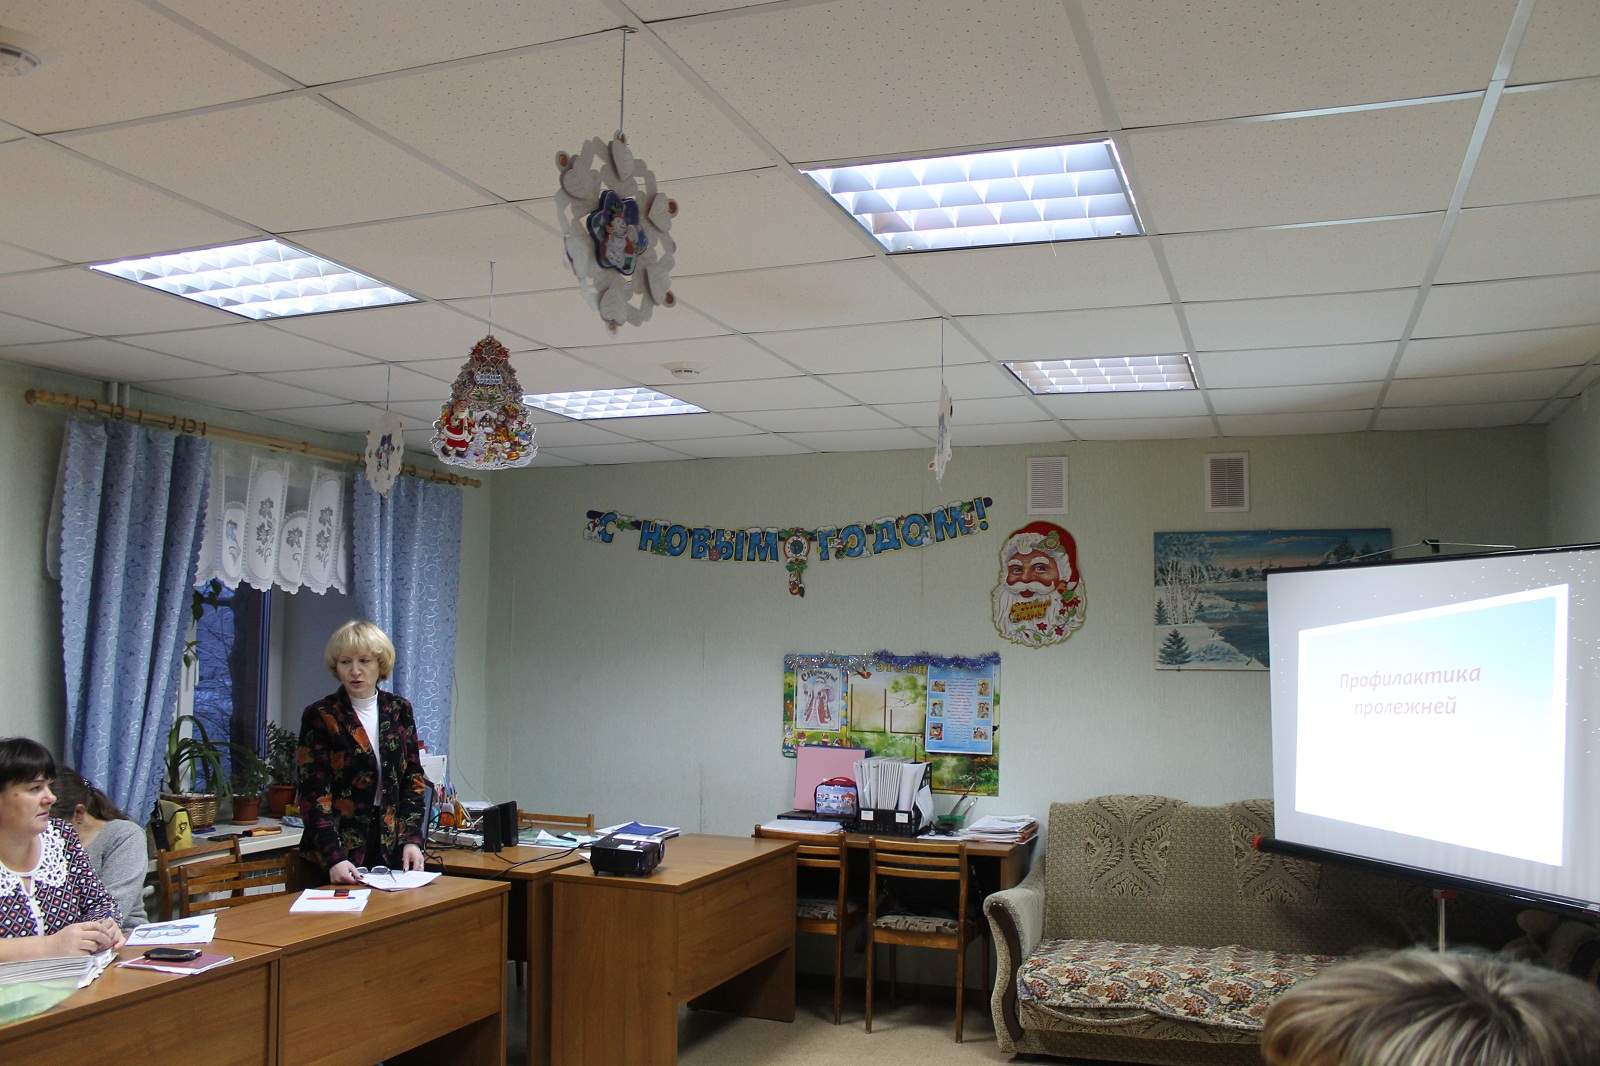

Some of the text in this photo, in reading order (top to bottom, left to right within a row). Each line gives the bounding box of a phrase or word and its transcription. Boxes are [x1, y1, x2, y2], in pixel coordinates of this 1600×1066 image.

[598, 497, 989, 562] С НОВЫМ ГОДОМ!
[1340, 667, 1481, 692] Профилактика
[1354, 695, 1457, 719] пролежней
